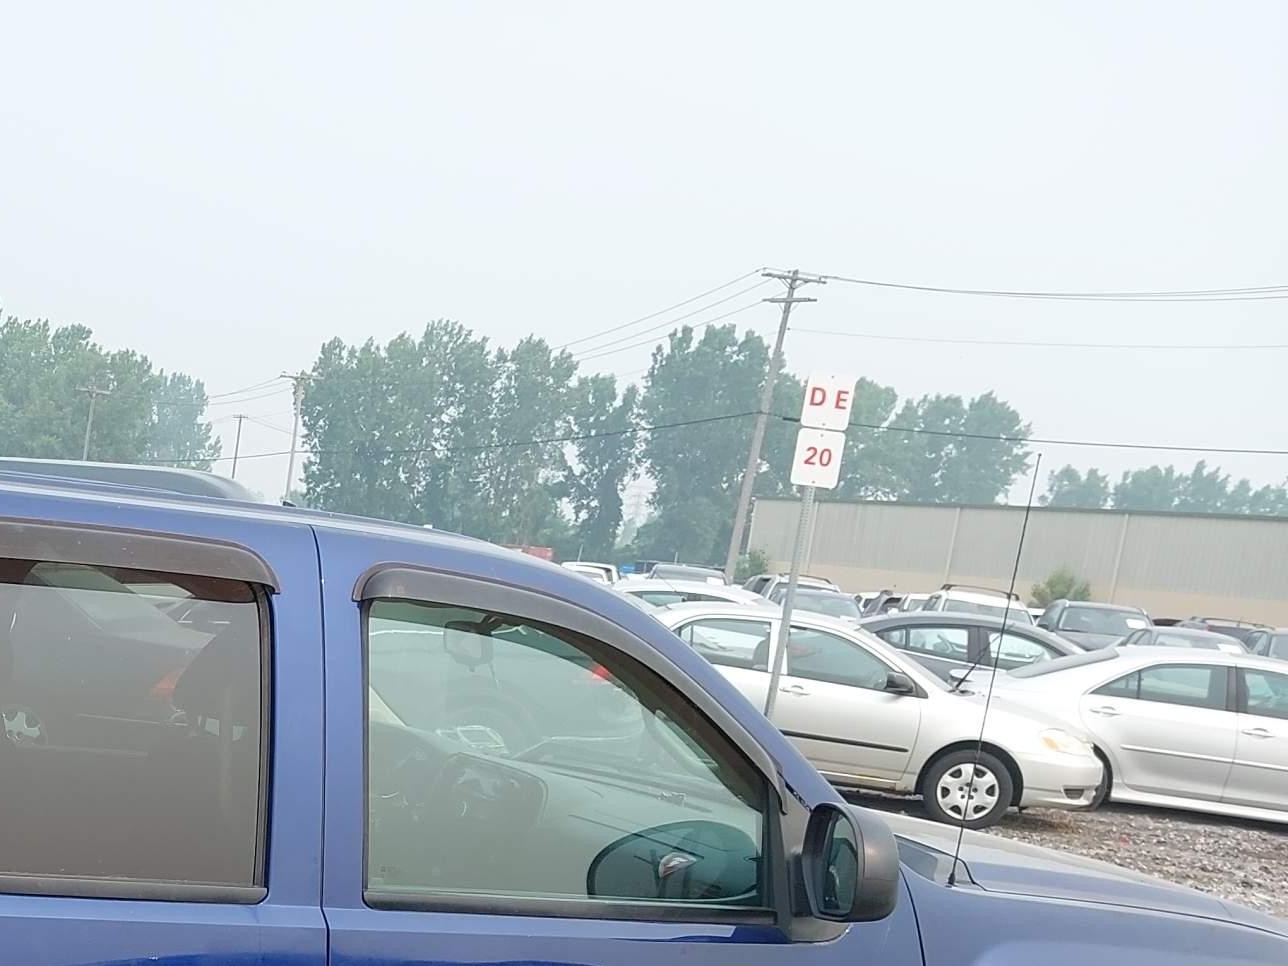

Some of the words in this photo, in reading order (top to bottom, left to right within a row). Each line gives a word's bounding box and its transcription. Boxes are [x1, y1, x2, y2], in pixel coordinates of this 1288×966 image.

[809, 386, 827, 406] D
[834, 390, 850, 410] E
[803, 446, 832, 467] 20
